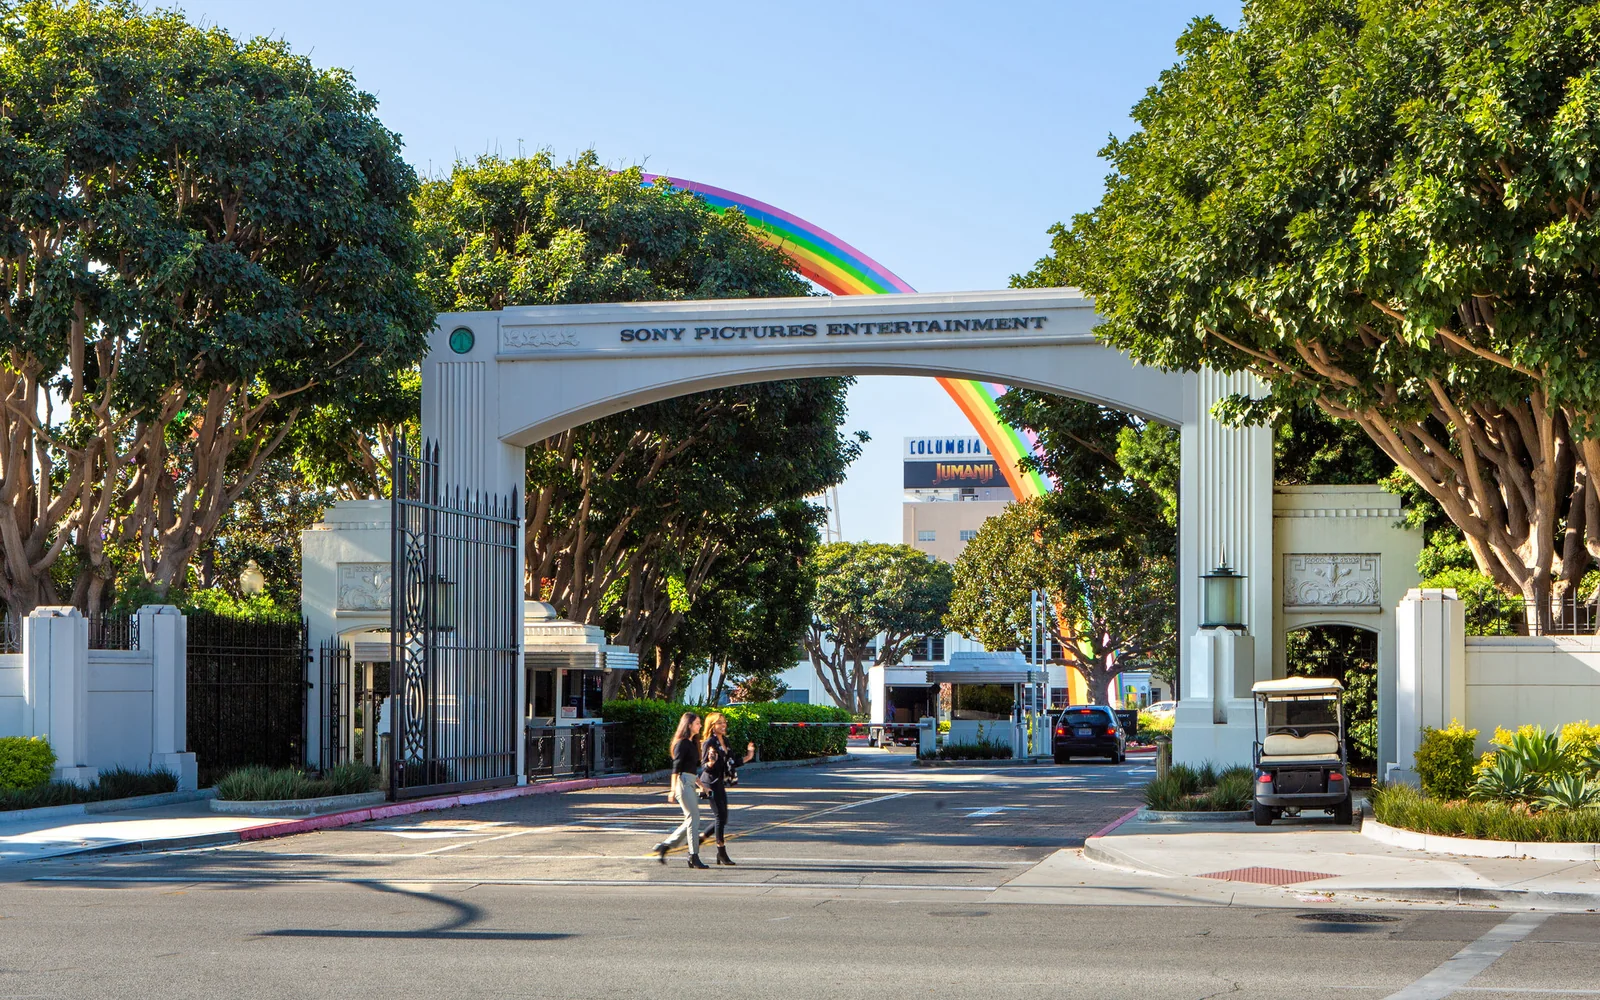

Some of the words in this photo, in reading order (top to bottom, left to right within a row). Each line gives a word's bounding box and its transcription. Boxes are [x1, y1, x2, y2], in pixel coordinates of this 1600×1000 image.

[620, 327, 686, 342] SONY
[694, 323, 817, 340] PICTURES
[826, 316, 1048, 336] ENTERTAINMENT
[910, 439, 981, 455] COLUMBIA
[932, 462, 994, 485] JUMANJI
